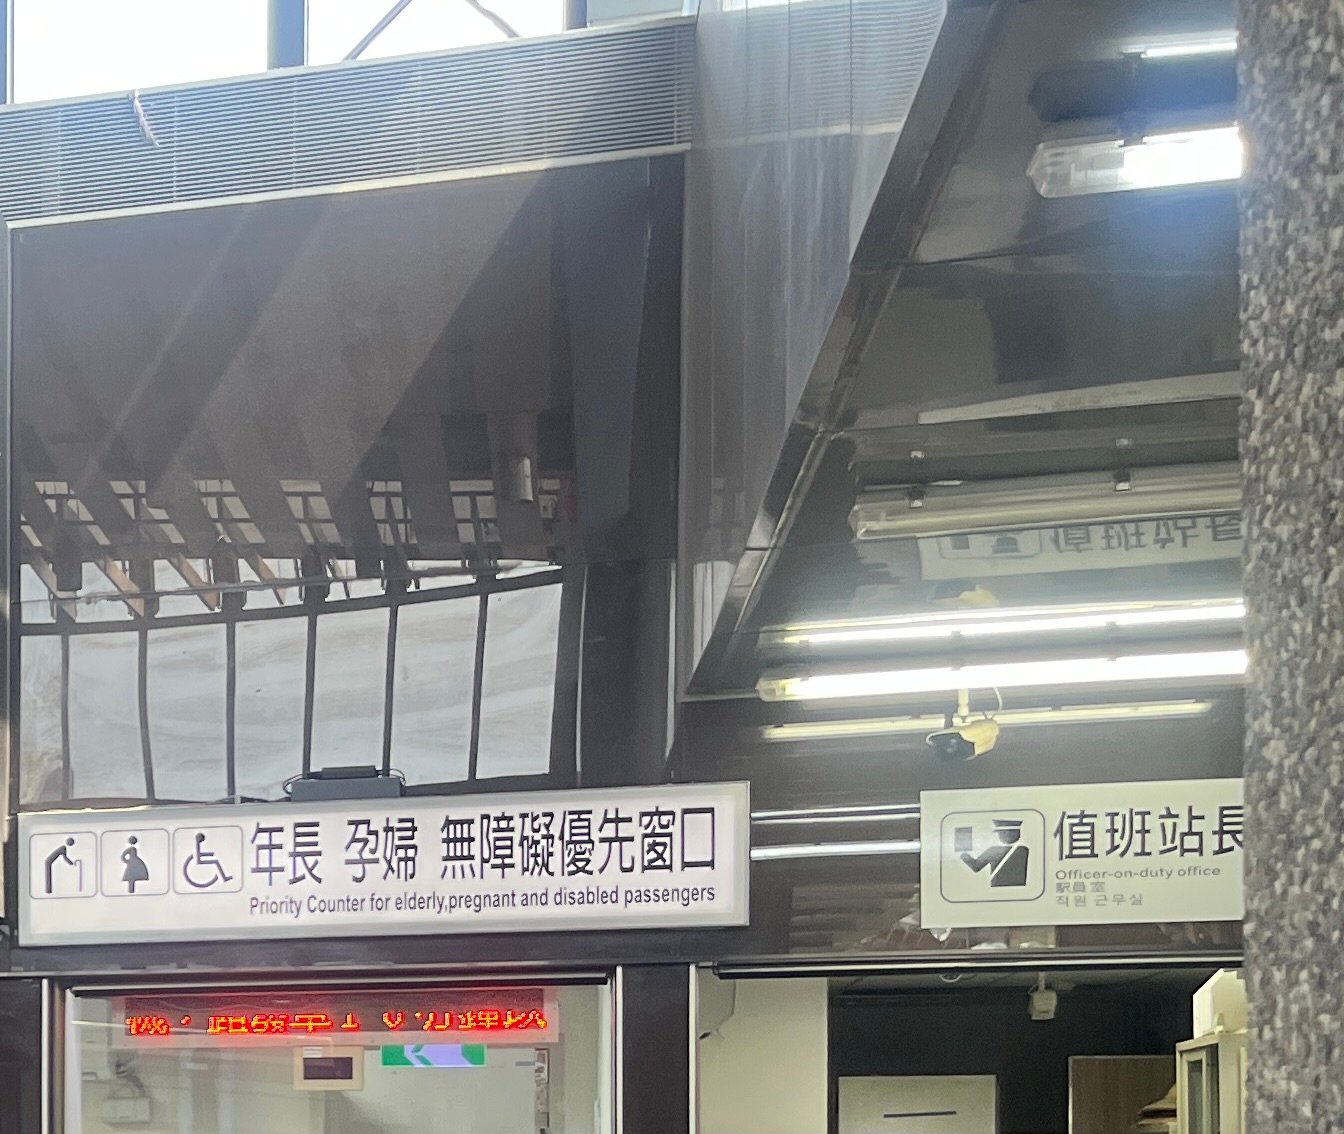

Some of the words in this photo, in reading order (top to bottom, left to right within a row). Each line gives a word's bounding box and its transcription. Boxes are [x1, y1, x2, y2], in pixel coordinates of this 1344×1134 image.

[250, 819, 322, 888] 年長
[344, 816, 418, 883] 孕婦
[440, 805, 717, 881] 無障礙優先窗口
[1053, 805, 1244, 861] 值班站長
[1055, 866, 1173, 880] Officer-on-duty
[1177, 865, 1221, 877] office
[249, 893, 302, 917] Priority
[306, 892, 366, 914] Counter
[368, 892, 390, 911] for
[519, 889, 548, 907] and
[552, 886, 619, 906] disabled
[623, 884, 716, 907] passengers
